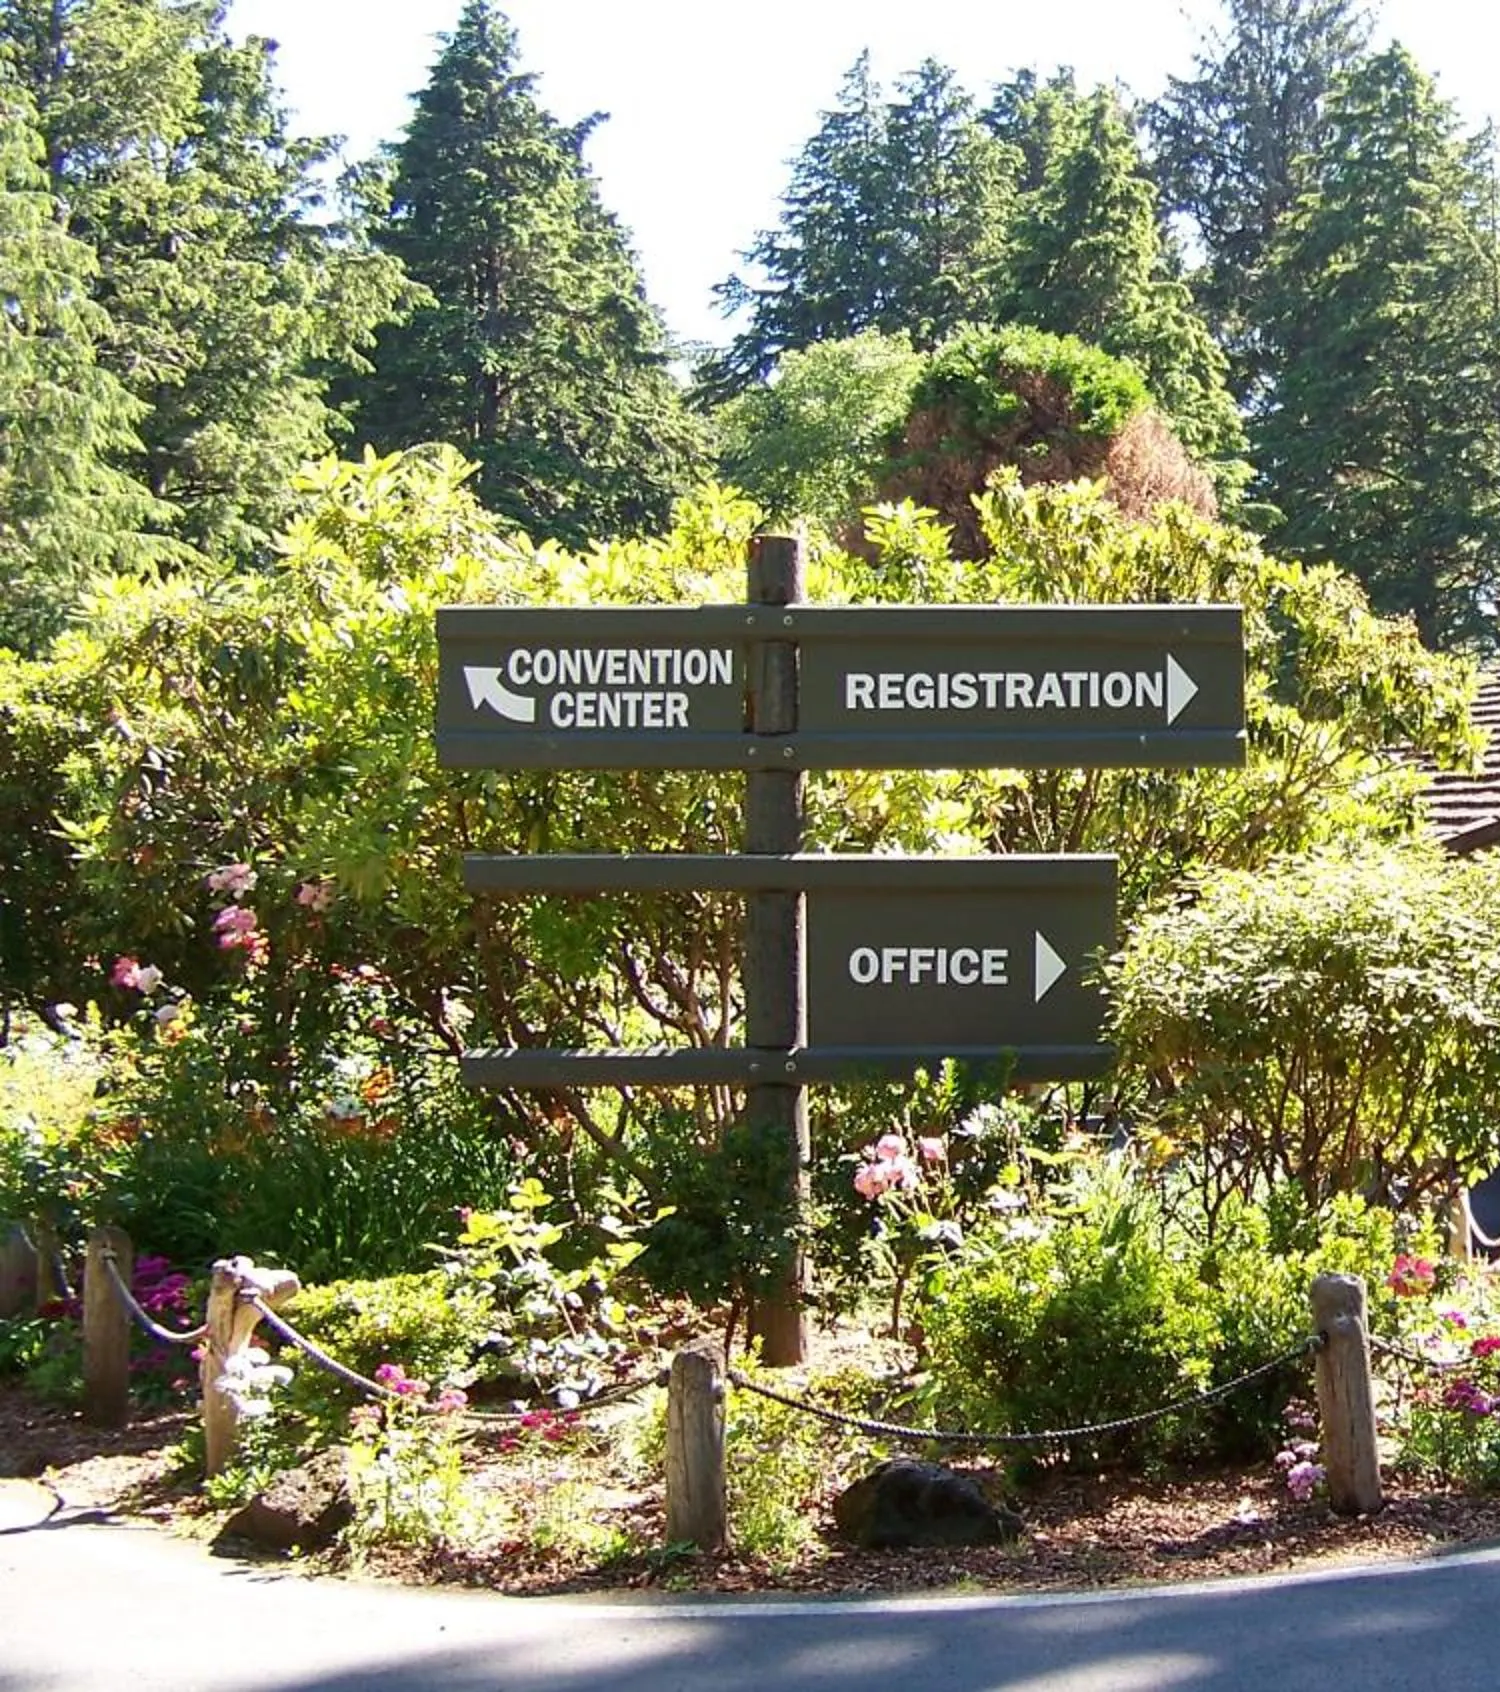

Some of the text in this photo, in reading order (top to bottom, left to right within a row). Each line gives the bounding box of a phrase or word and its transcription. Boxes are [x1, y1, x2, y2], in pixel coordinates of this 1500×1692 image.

[507, 648, 733, 686] CONVENTION
[550, 691, 689, 728] CENTER
[845, 671, 1163, 710] REGISTRATION
[849, 947, 1009, 985] OFFICE
